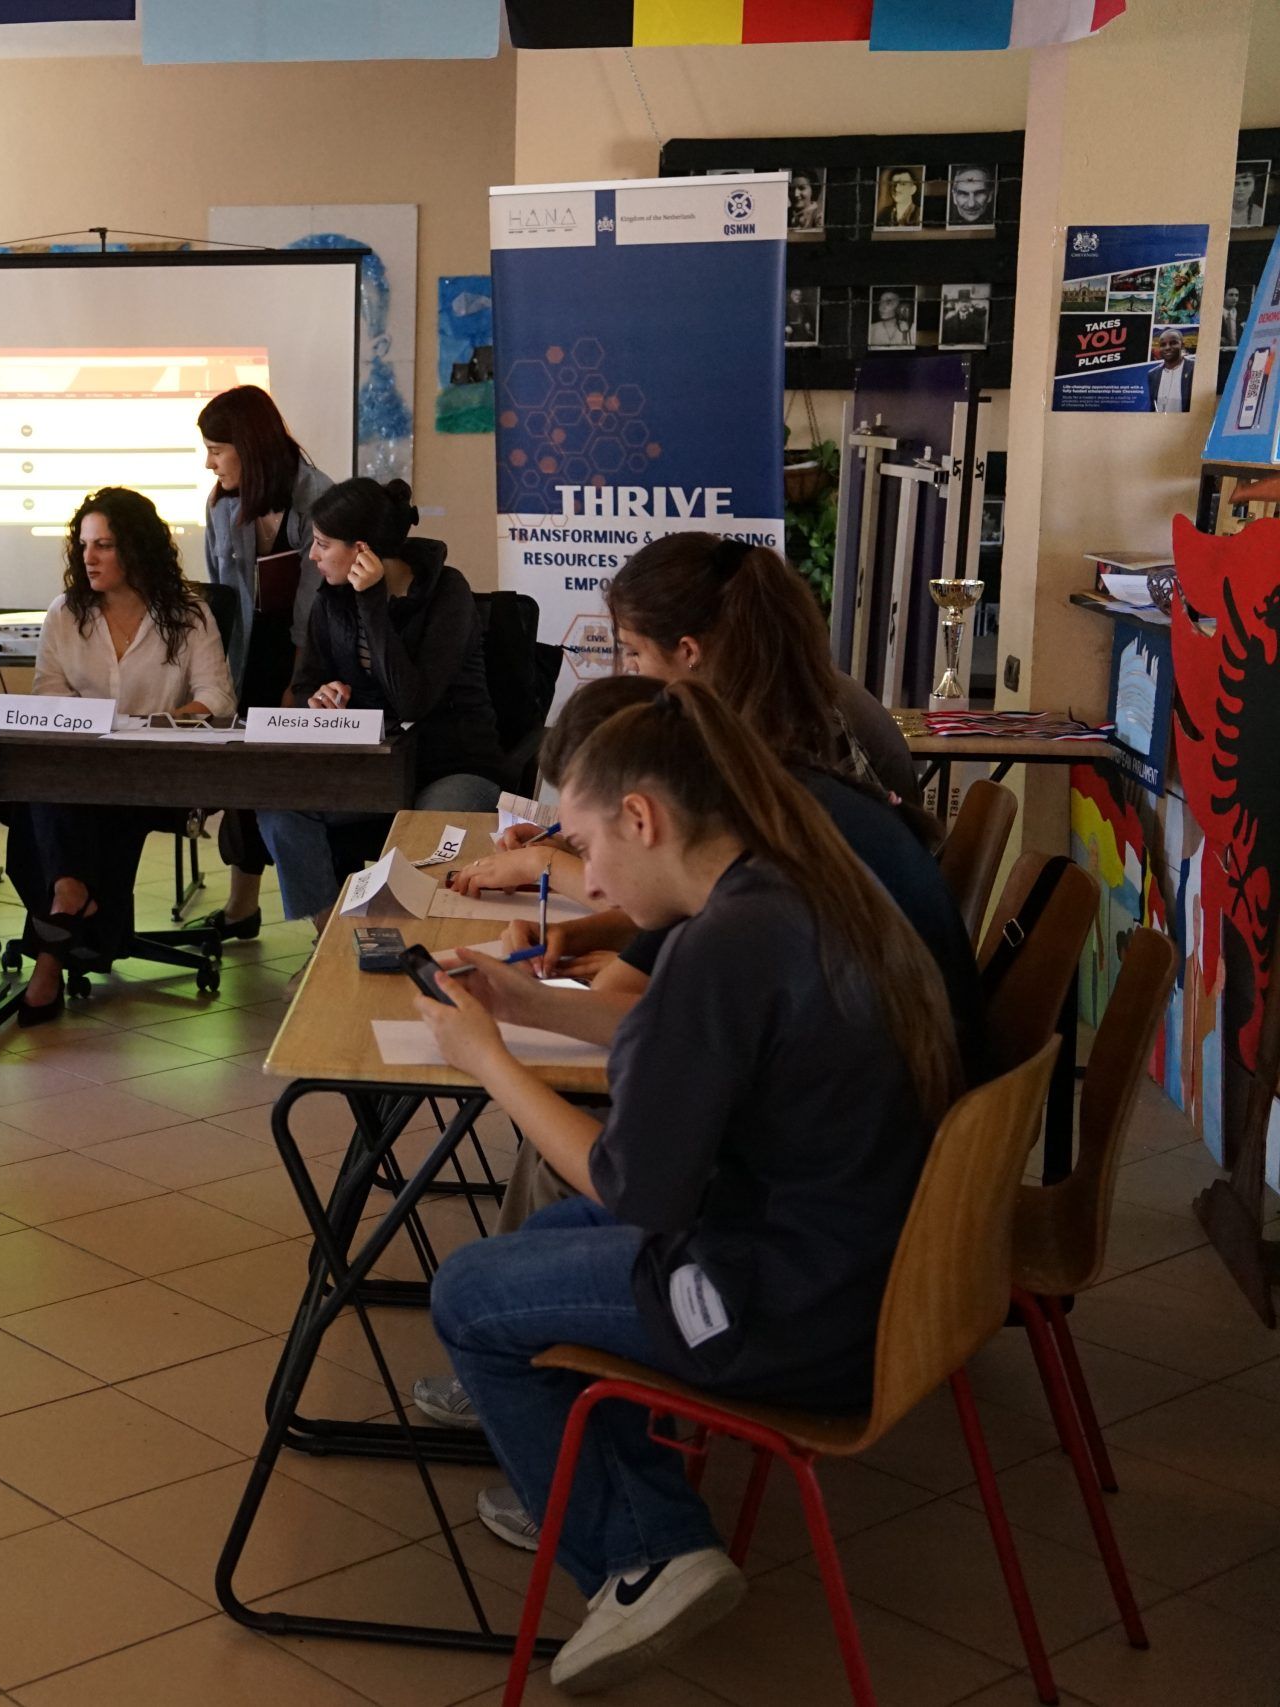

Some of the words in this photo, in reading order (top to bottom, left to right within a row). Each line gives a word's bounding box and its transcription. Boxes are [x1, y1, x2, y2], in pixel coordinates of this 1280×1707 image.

[723, 223, 756, 236] QSNNN
[1085, 318, 1121, 332] TAKES
[1077, 327, 1127, 350] YOU
[1078, 352, 1121, 367] PLACES
[554, 485, 735, 519] THRIVE
[508, 527, 639, 545] TRANSFORMING
[523, 552, 618, 568] RESOURCES
[565, 577, 616, 592] EMPO
[6, 710, 48, 726] Elona
[53, 713, 93, 731] Capo
[267, 715, 309, 728] Alesia
[313, 716, 361, 729] Sadiku
